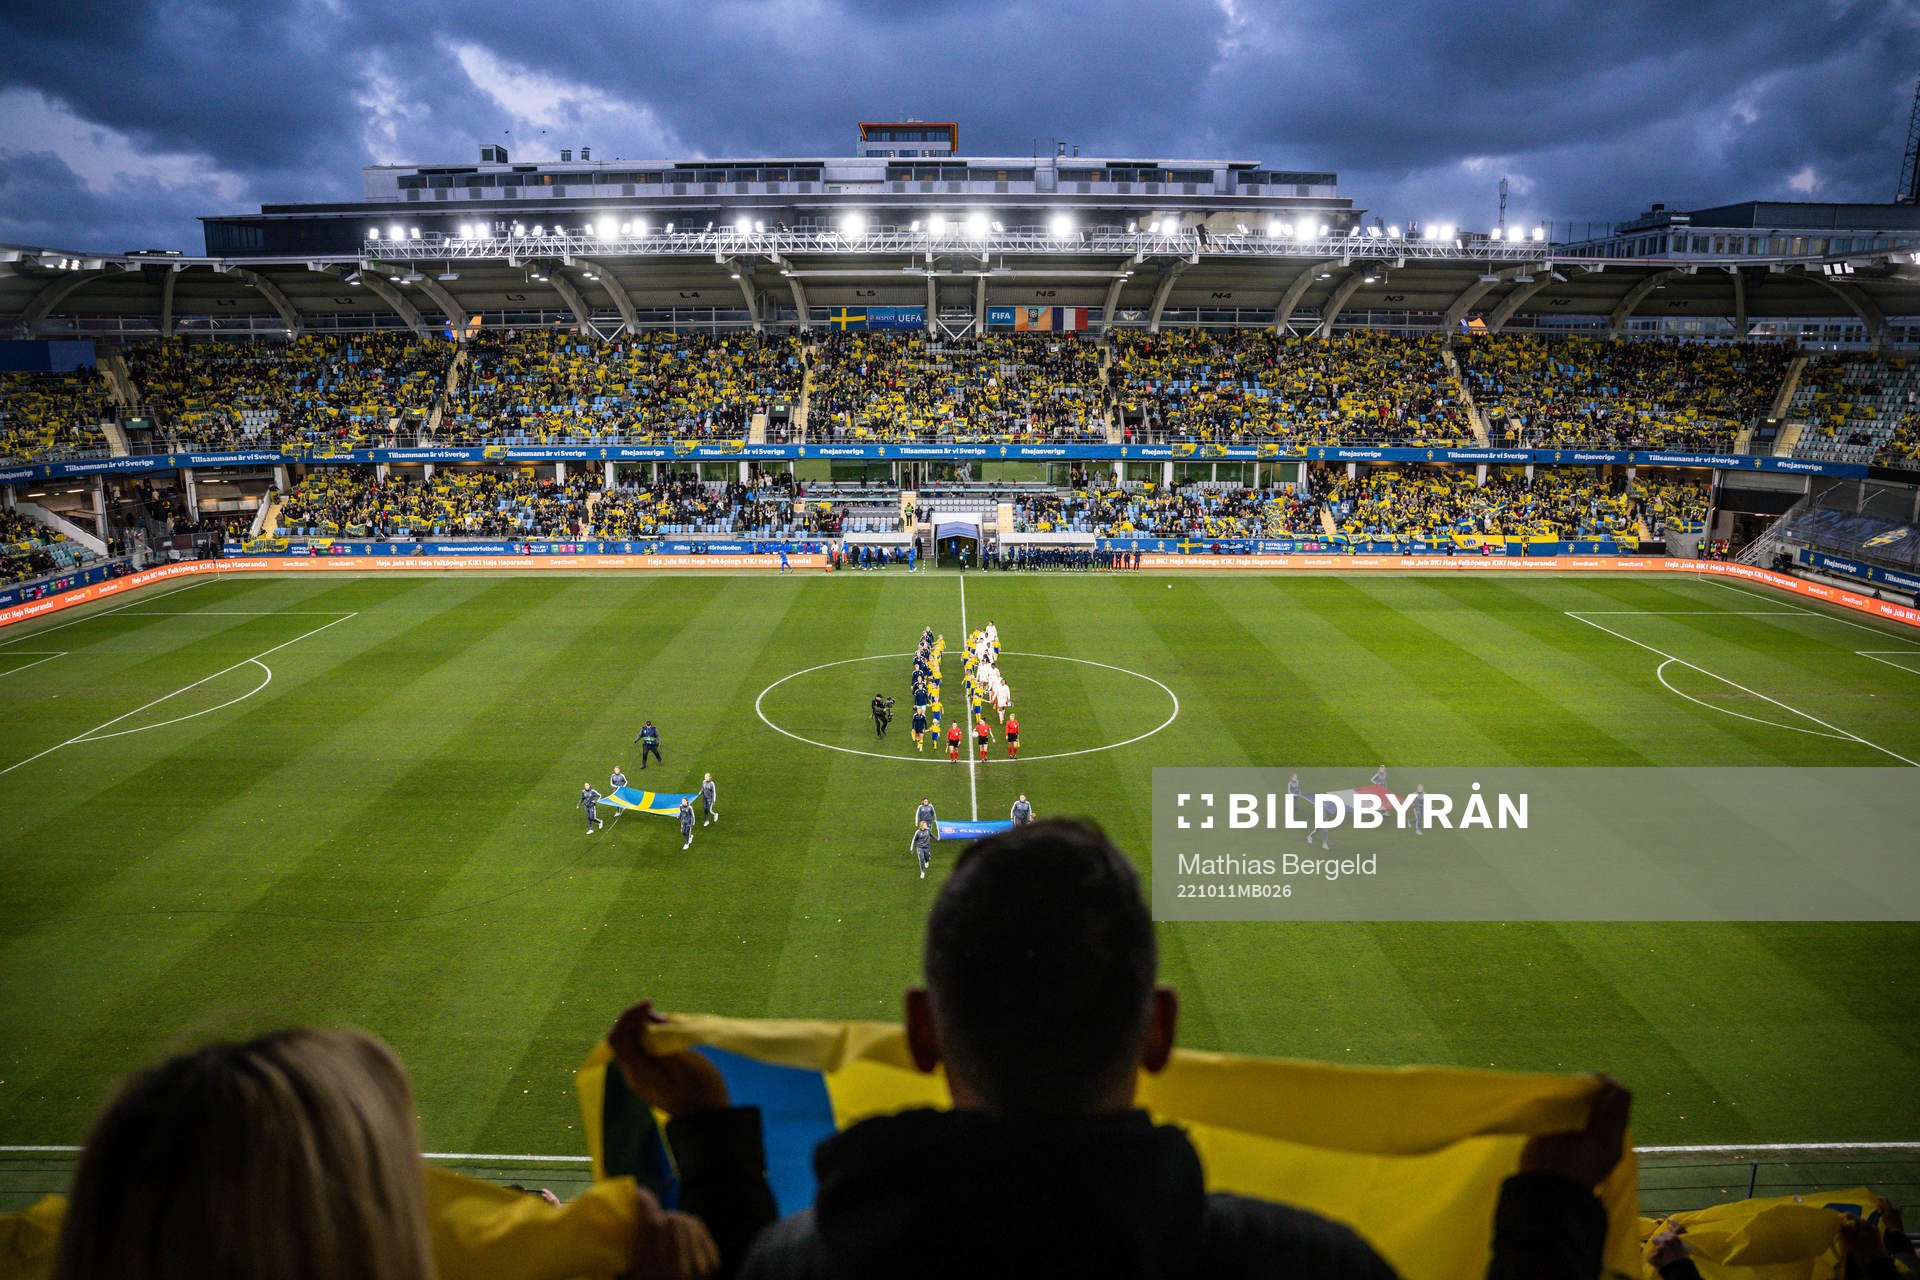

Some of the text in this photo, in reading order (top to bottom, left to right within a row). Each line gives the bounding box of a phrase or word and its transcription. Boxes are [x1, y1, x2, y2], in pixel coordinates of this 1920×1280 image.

[898, 314, 922, 322] UEFA
[991, 312, 1011, 320] FIFA
[445, 451, 470, 459] Sverige
[759, 448, 785, 456] Sverige
[959, 447, 986, 455] Sverige
[254, 453, 281, 462] Sverige
[1503, 452, 1528, 460] Sverige
[1574, 453, 1616, 461] #hejasverige
[1649, 454, 1694, 462] Tillsammans
[1711, 457, 1740, 465] Sverige
[64, 463, 108, 472] Tillsammans
[125, 459, 154, 468] Sverige
[1777, 461, 1823, 471] #hejasverige
[1823, 558, 1857, 573] #hejasverige
[1665, 560, 1679, 568] Heja
[1763, 573, 1773, 582] Heja
[132, 576, 142, 584] Heja
[158, 570, 167, 578] Heja
[1880, 605, 1892, 615] Heja
